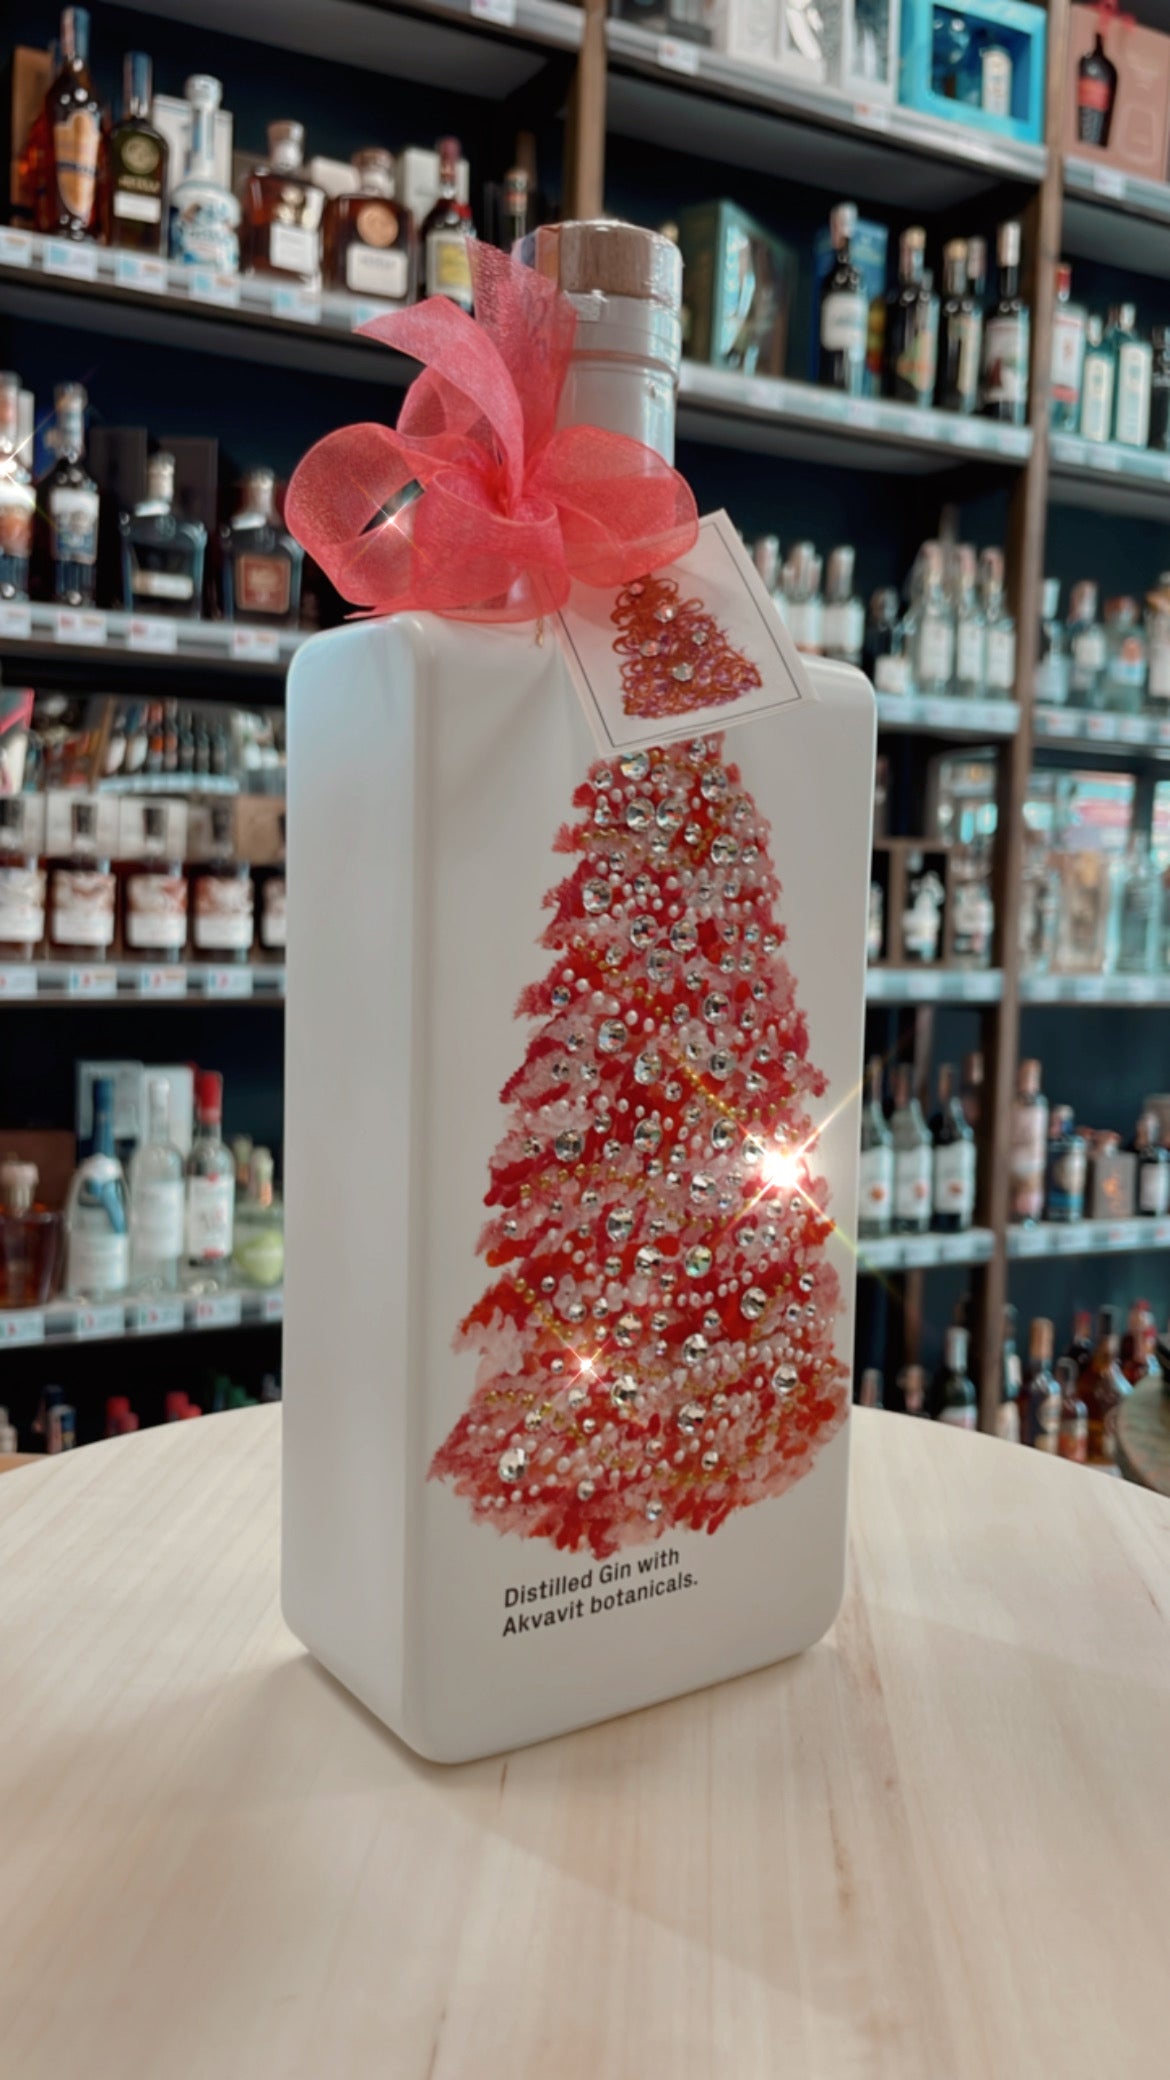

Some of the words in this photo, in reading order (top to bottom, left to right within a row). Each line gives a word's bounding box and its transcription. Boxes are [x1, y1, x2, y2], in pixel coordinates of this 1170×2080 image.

[502, 1601, 585, 1637] Akvavit
[590, 1571, 698, 1614] botanicals.
[504, 1569, 593, 1608] Distilled
[600, 1563, 631, 1585] Gin
[637, 1548, 680, 1574] with
